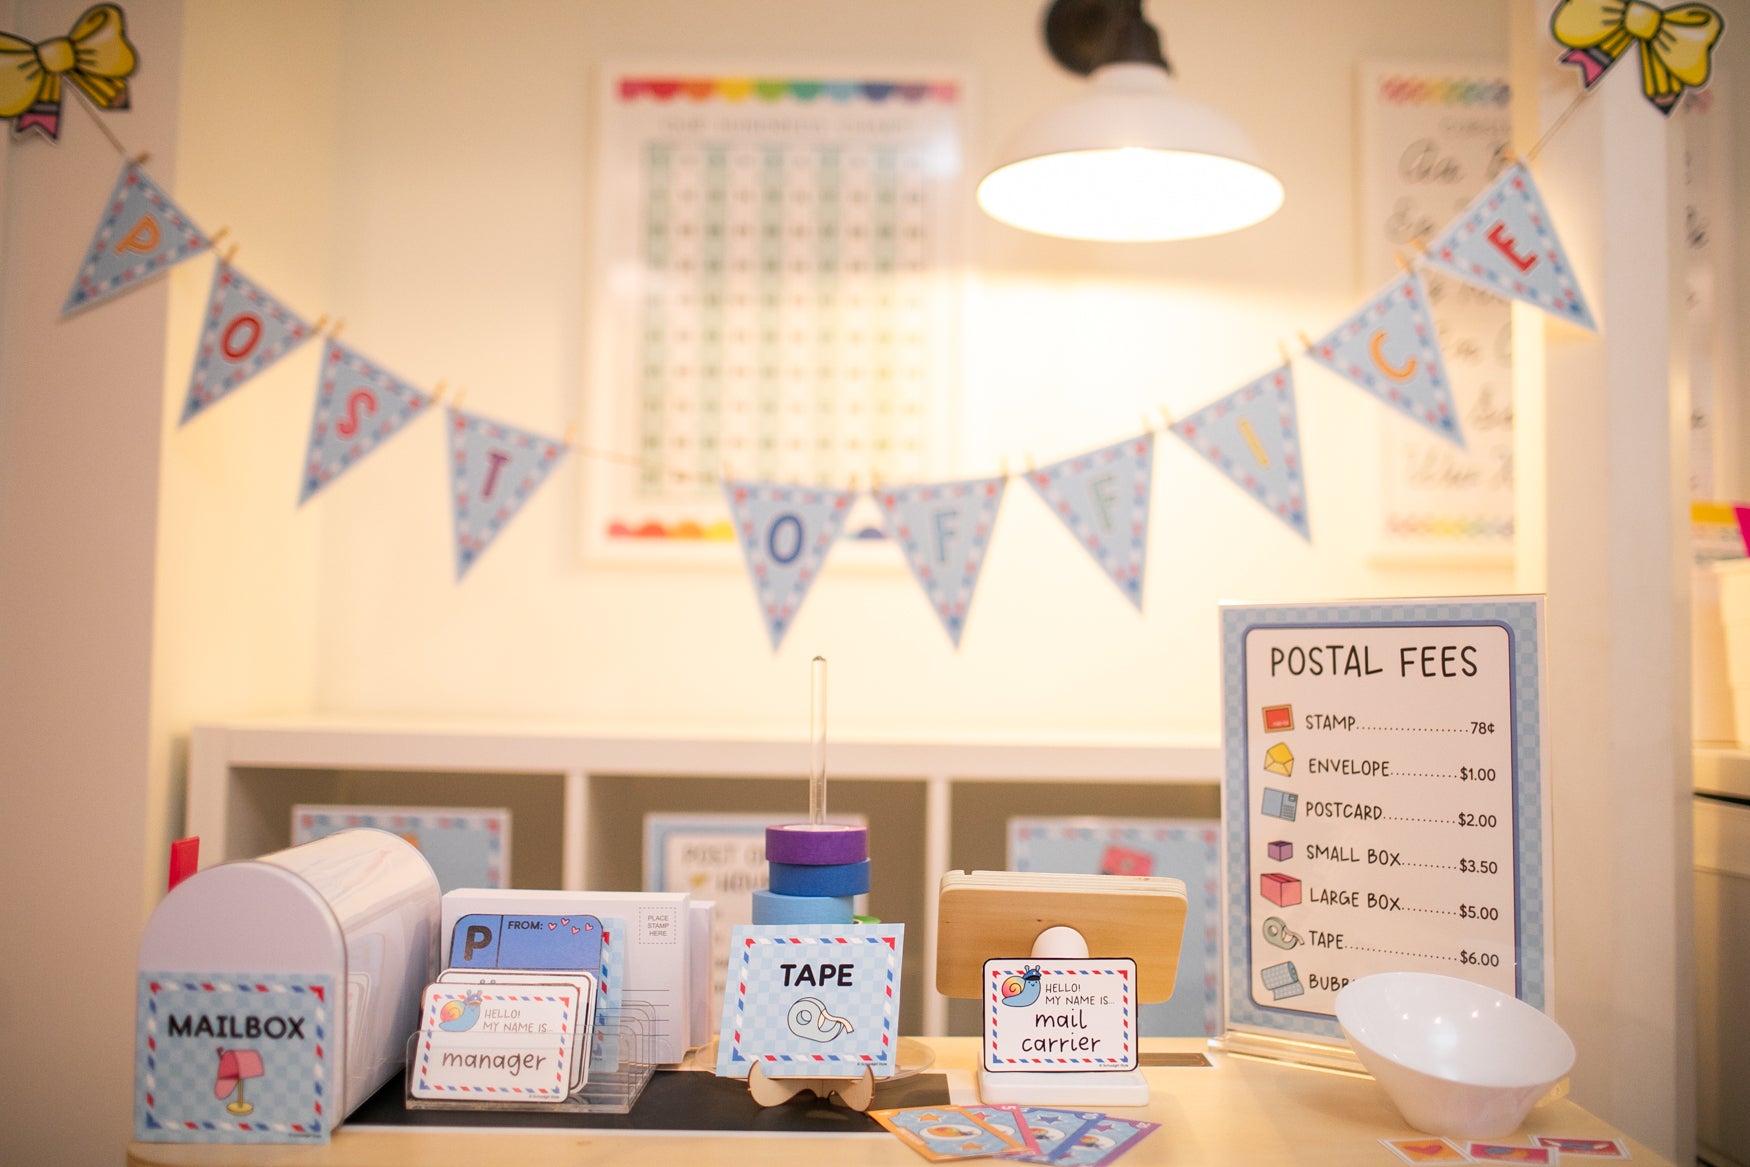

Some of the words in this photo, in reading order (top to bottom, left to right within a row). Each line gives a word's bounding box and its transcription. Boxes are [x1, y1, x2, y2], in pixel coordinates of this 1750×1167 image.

[1271, 645, 1383, 677] POSTAL
[1400, 645, 1478, 677] FEES
[1470, 721, 1496, 735] 78¢
[1459, 767, 1496, 782] $1.00
[1458, 813, 1497, 829] $2.00
[1306, 845, 1360, 863] SMALL
[1459, 858, 1498, 875] $3.50
[1310, 888, 1359, 907] LARGE
[1459, 904, 1499, 921] $5.00
[508, 921, 543, 930] FROM:
[464, 925, 492, 961] P
[1309, 930, 1344, 950] TAPE
[1459, 950, 1500, 967] $6.00
[780, 963, 854, 987] TAPE
[1045, 983, 1081, 993] HELLO!
[1045, 995, 1061, 1005] MY
[1065, 995, 1095, 1005] NAME
[484, 1009, 521, 1019] HELLO!
[1035, 1008, 1087, 1029] mail
[168, 1014, 305, 1040] MAILBOX
[483, 1021, 499, 1032] MY
[503, 1022, 534, 1032] NAME
[1021, 1032, 1101, 1053] carrier
[442, 1051, 547, 1077] manager
